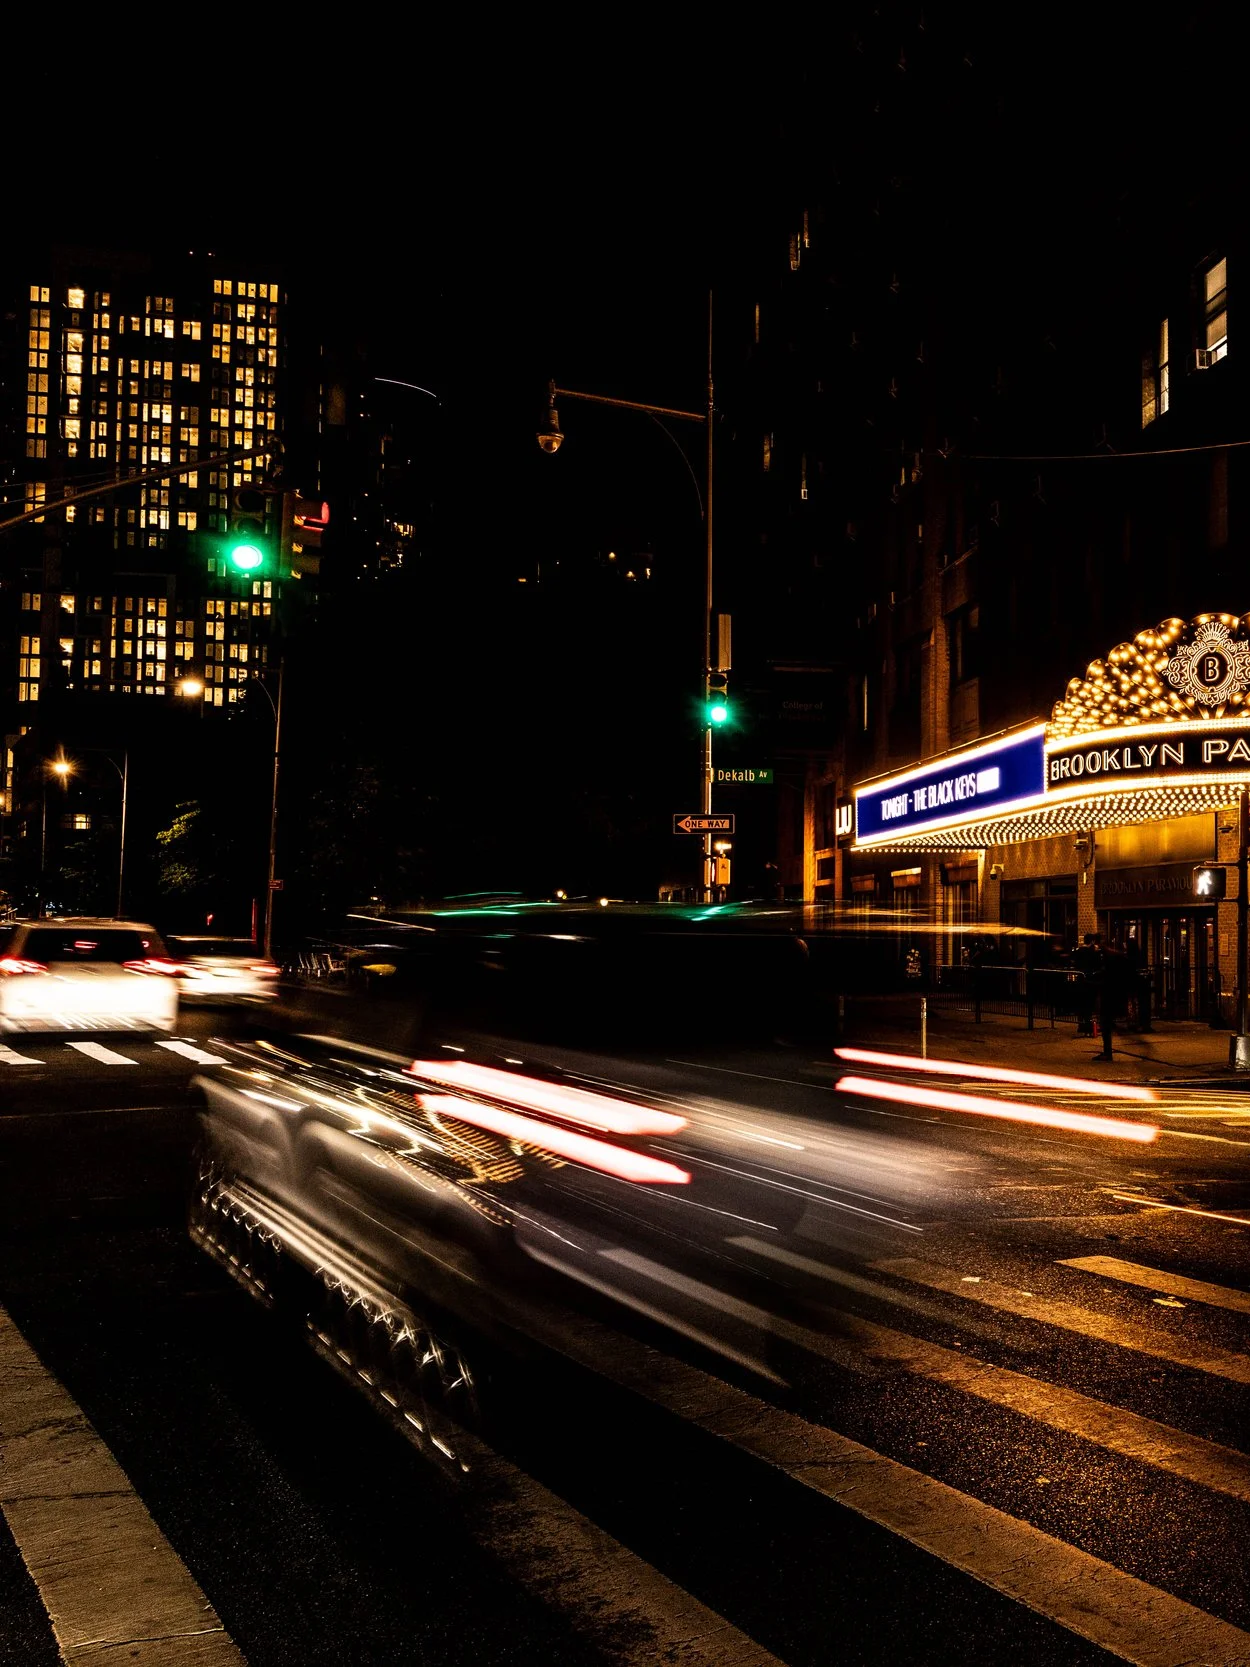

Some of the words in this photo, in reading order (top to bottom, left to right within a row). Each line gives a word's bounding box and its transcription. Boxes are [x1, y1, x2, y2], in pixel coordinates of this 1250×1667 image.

[1204, 656, 1219, 682] B
[718, 769, 755, 781] Dekalb
[759, 770, 768, 778] Av
[1051, 743, 1184, 781] BROOKLYN
[881, 793, 908, 821] TONIGHT
[913, 788, 928, 812] THE
[928, 779, 954, 808] BLACK
[954, 772, 976, 801] KEYS
[685, 820, 703, 828] ONE
[707, 820, 726, 828] WAY
